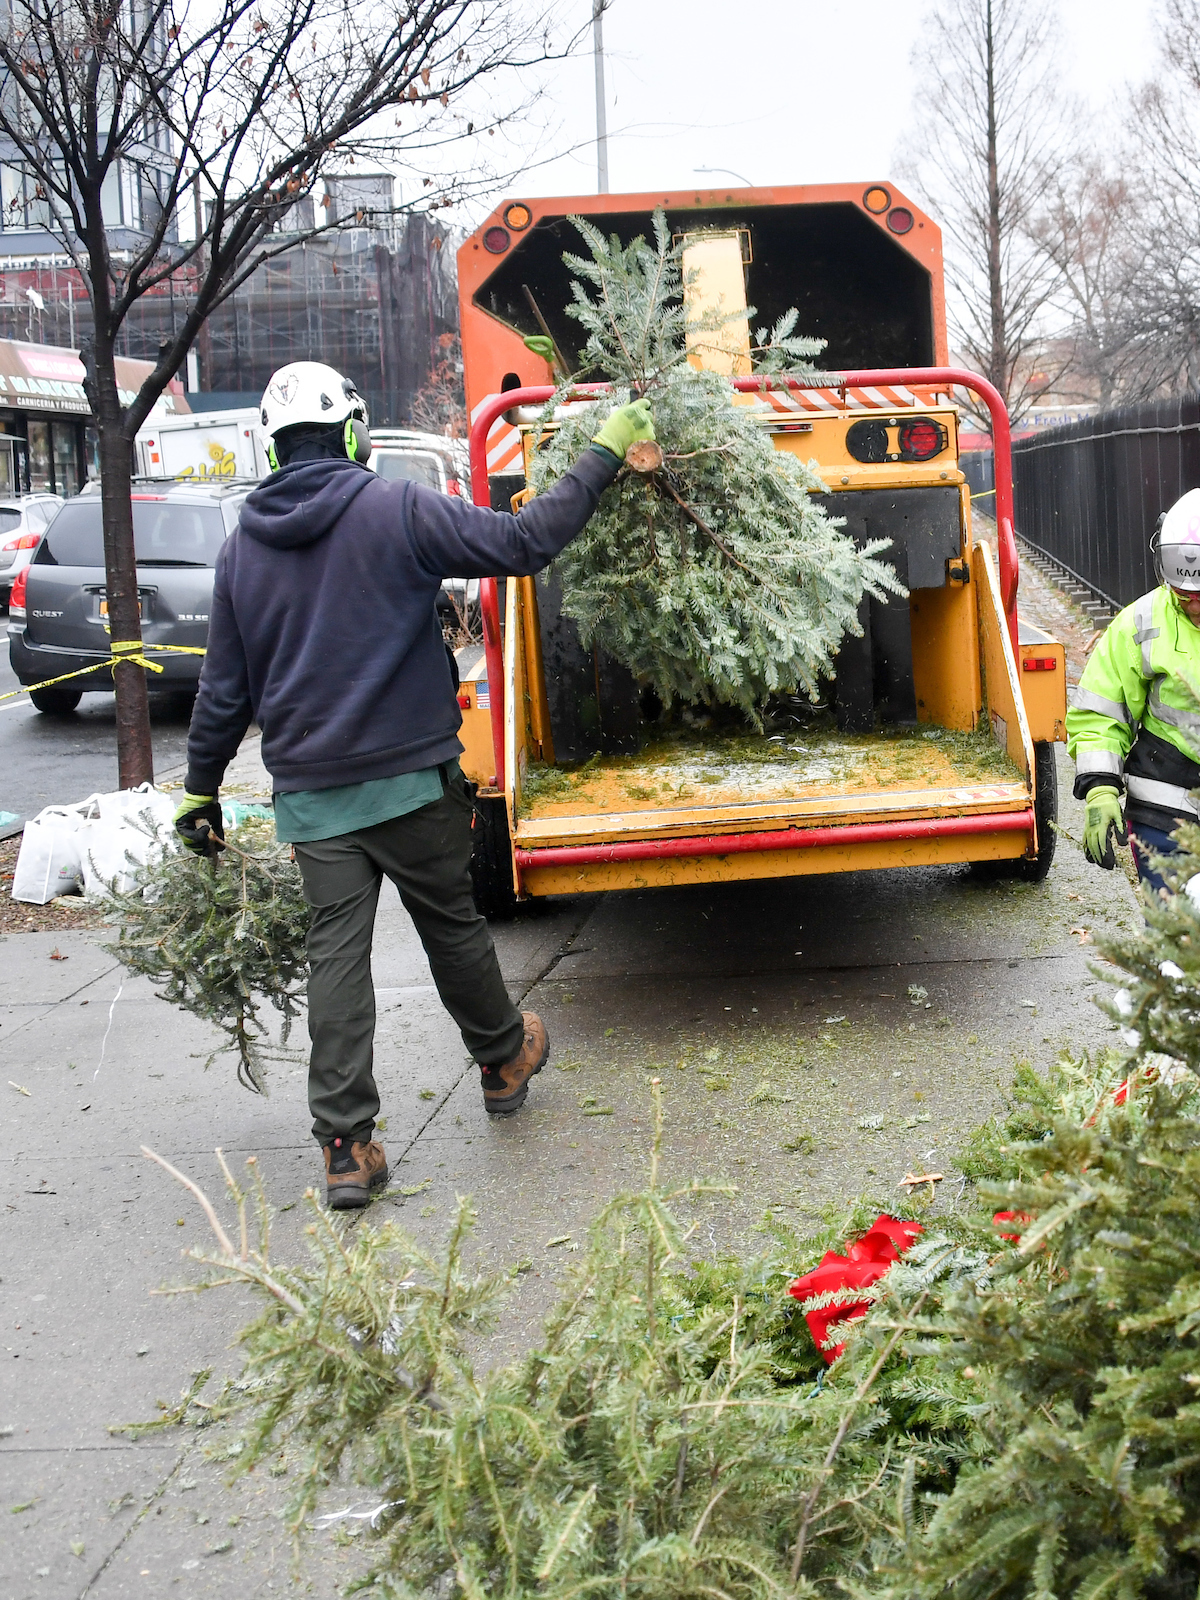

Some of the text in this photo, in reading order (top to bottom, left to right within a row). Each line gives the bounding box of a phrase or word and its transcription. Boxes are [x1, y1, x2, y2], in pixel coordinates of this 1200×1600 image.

[8, 375, 88, 400] MARKET
[16, 397, 55, 408] CARNICERIA
[32, 610, 63, 618] QUEST
